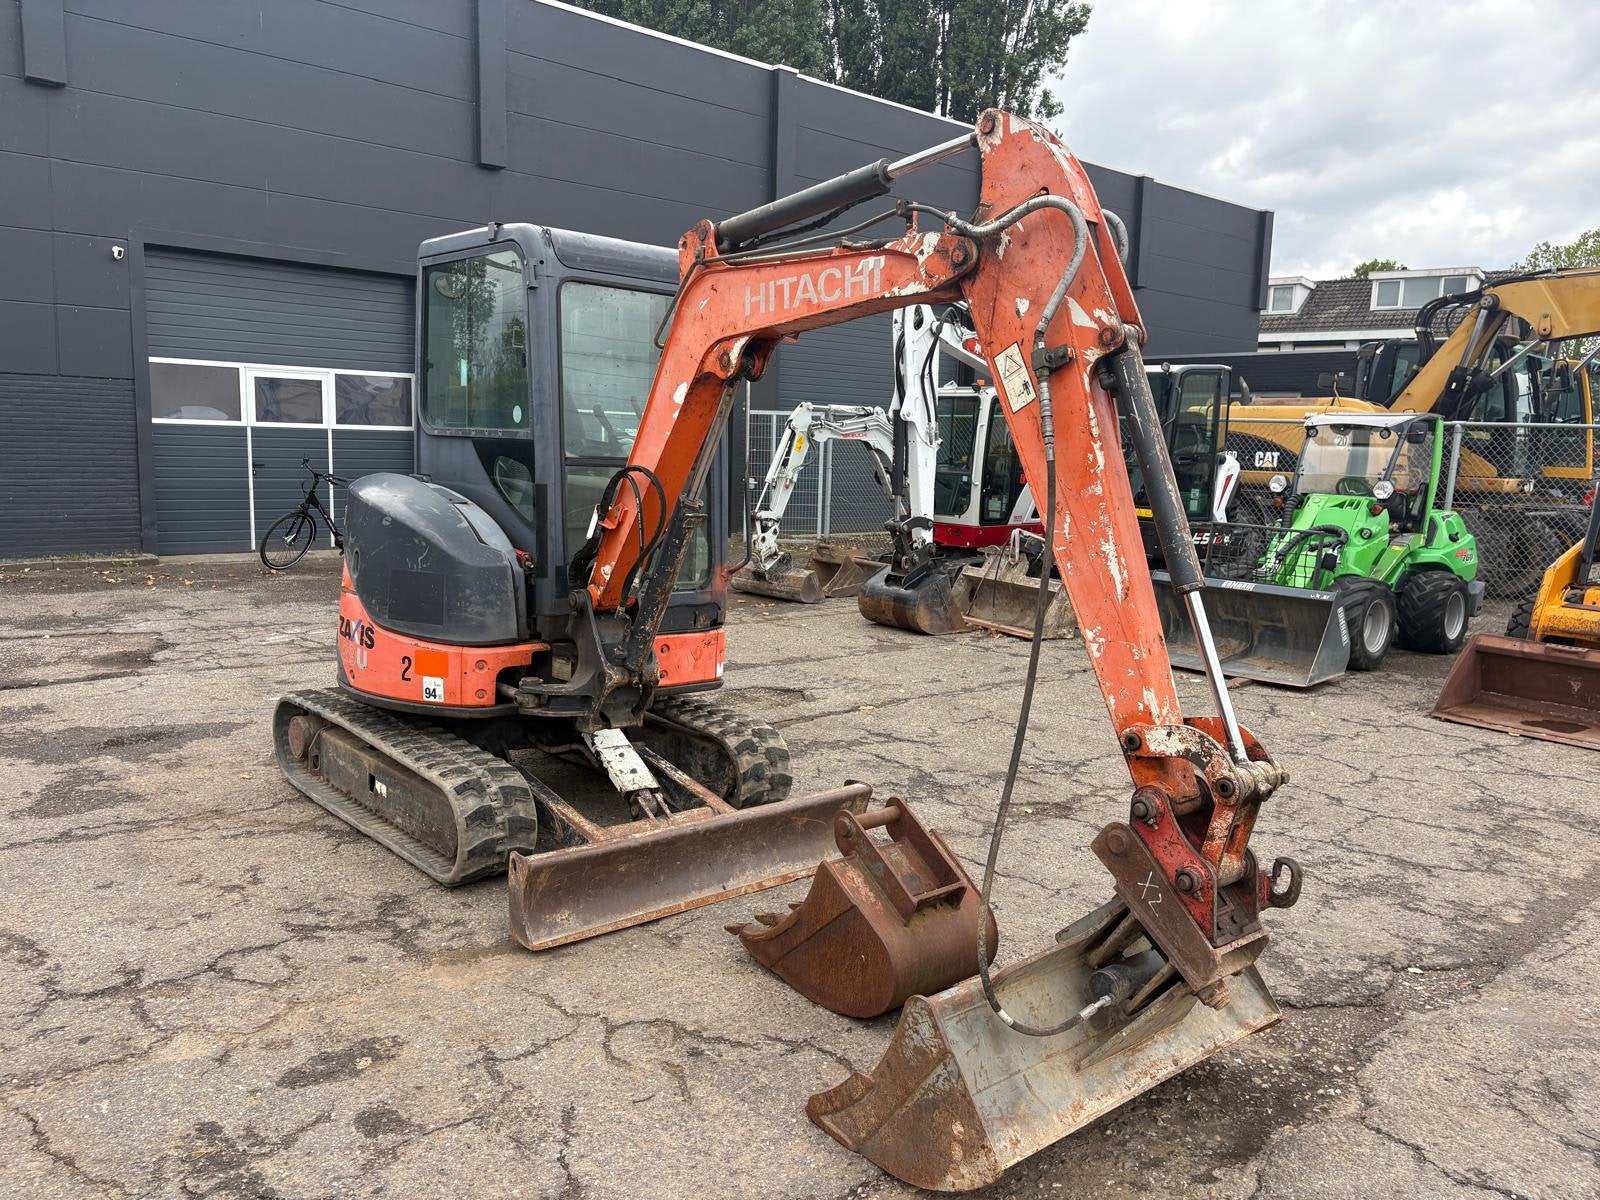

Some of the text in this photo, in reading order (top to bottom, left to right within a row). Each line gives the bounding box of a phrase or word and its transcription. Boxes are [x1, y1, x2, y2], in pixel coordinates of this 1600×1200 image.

[744, 257, 882, 316] HITACHI
[1337, 435, 1347, 446] 20
[1254, 451, 1280, 467] CAT
[339, 615, 375, 649] ZAXIS
[401, 655, 412, 682] 2
[425, 687, 437, 699] 94
